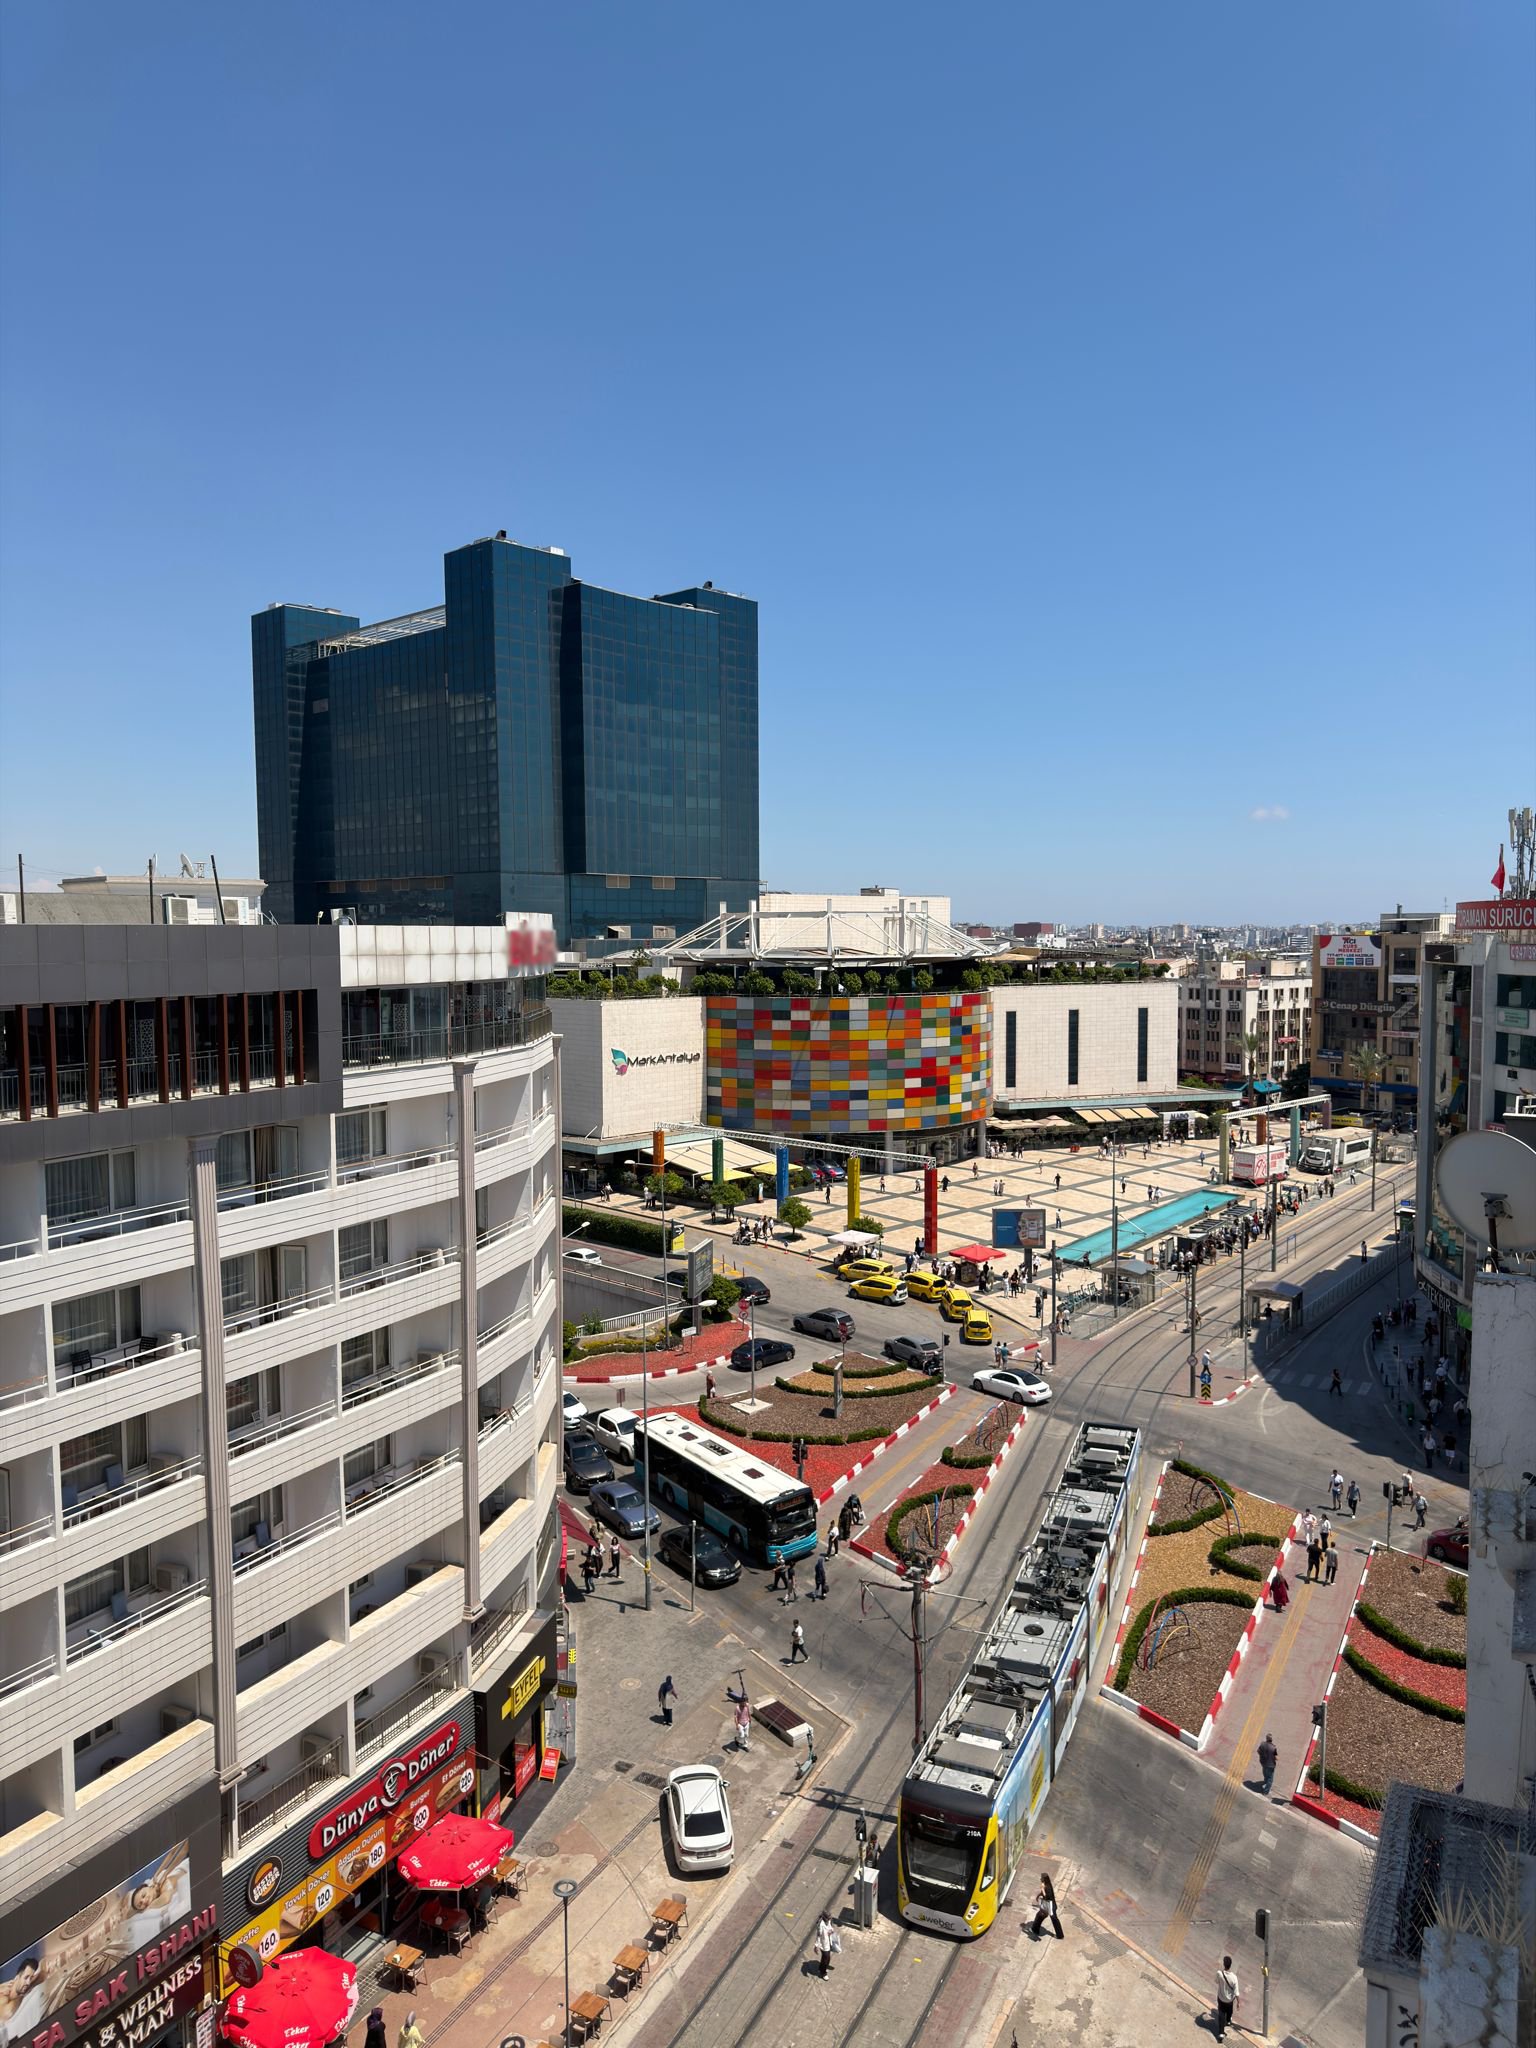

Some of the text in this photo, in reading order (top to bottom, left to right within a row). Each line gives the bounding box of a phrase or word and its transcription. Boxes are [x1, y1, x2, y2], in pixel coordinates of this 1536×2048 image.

[1489, 903, 1536, 927] SÜRÜC
[1330, 1001, 1396, 1013] Cenap Düzgün
[627, 1052, 701, 1067] MarkAntalya
[514, 1664, 539, 1704] EYFEL
[460, 1771, 473, 1789] 220
[322, 1734, 454, 1848] Dünya Döner
[410, 1789, 431, 1809] Burger
[414, 1808, 429, 1827] 200
[337, 1826, 385, 1867] Adana Dürüm
[370, 1845, 383, 1864] 180
[429, 1879, 450, 1887] Eker
[285, 1888, 306, 1911] Tavuk
[317, 1889, 330, 1907] 120
[925, 1916, 955, 1928] weber
[237, 1926, 260, 1945] Köfte
[260, 1933, 277, 1952] 160
[74, 1970, 129, 2026] SAK
[136, 1903, 217, 1982] İŞHANI
[117, 1955, 202, 2031] WELLNESS
[284, 2025, 310, 2038] Eker
